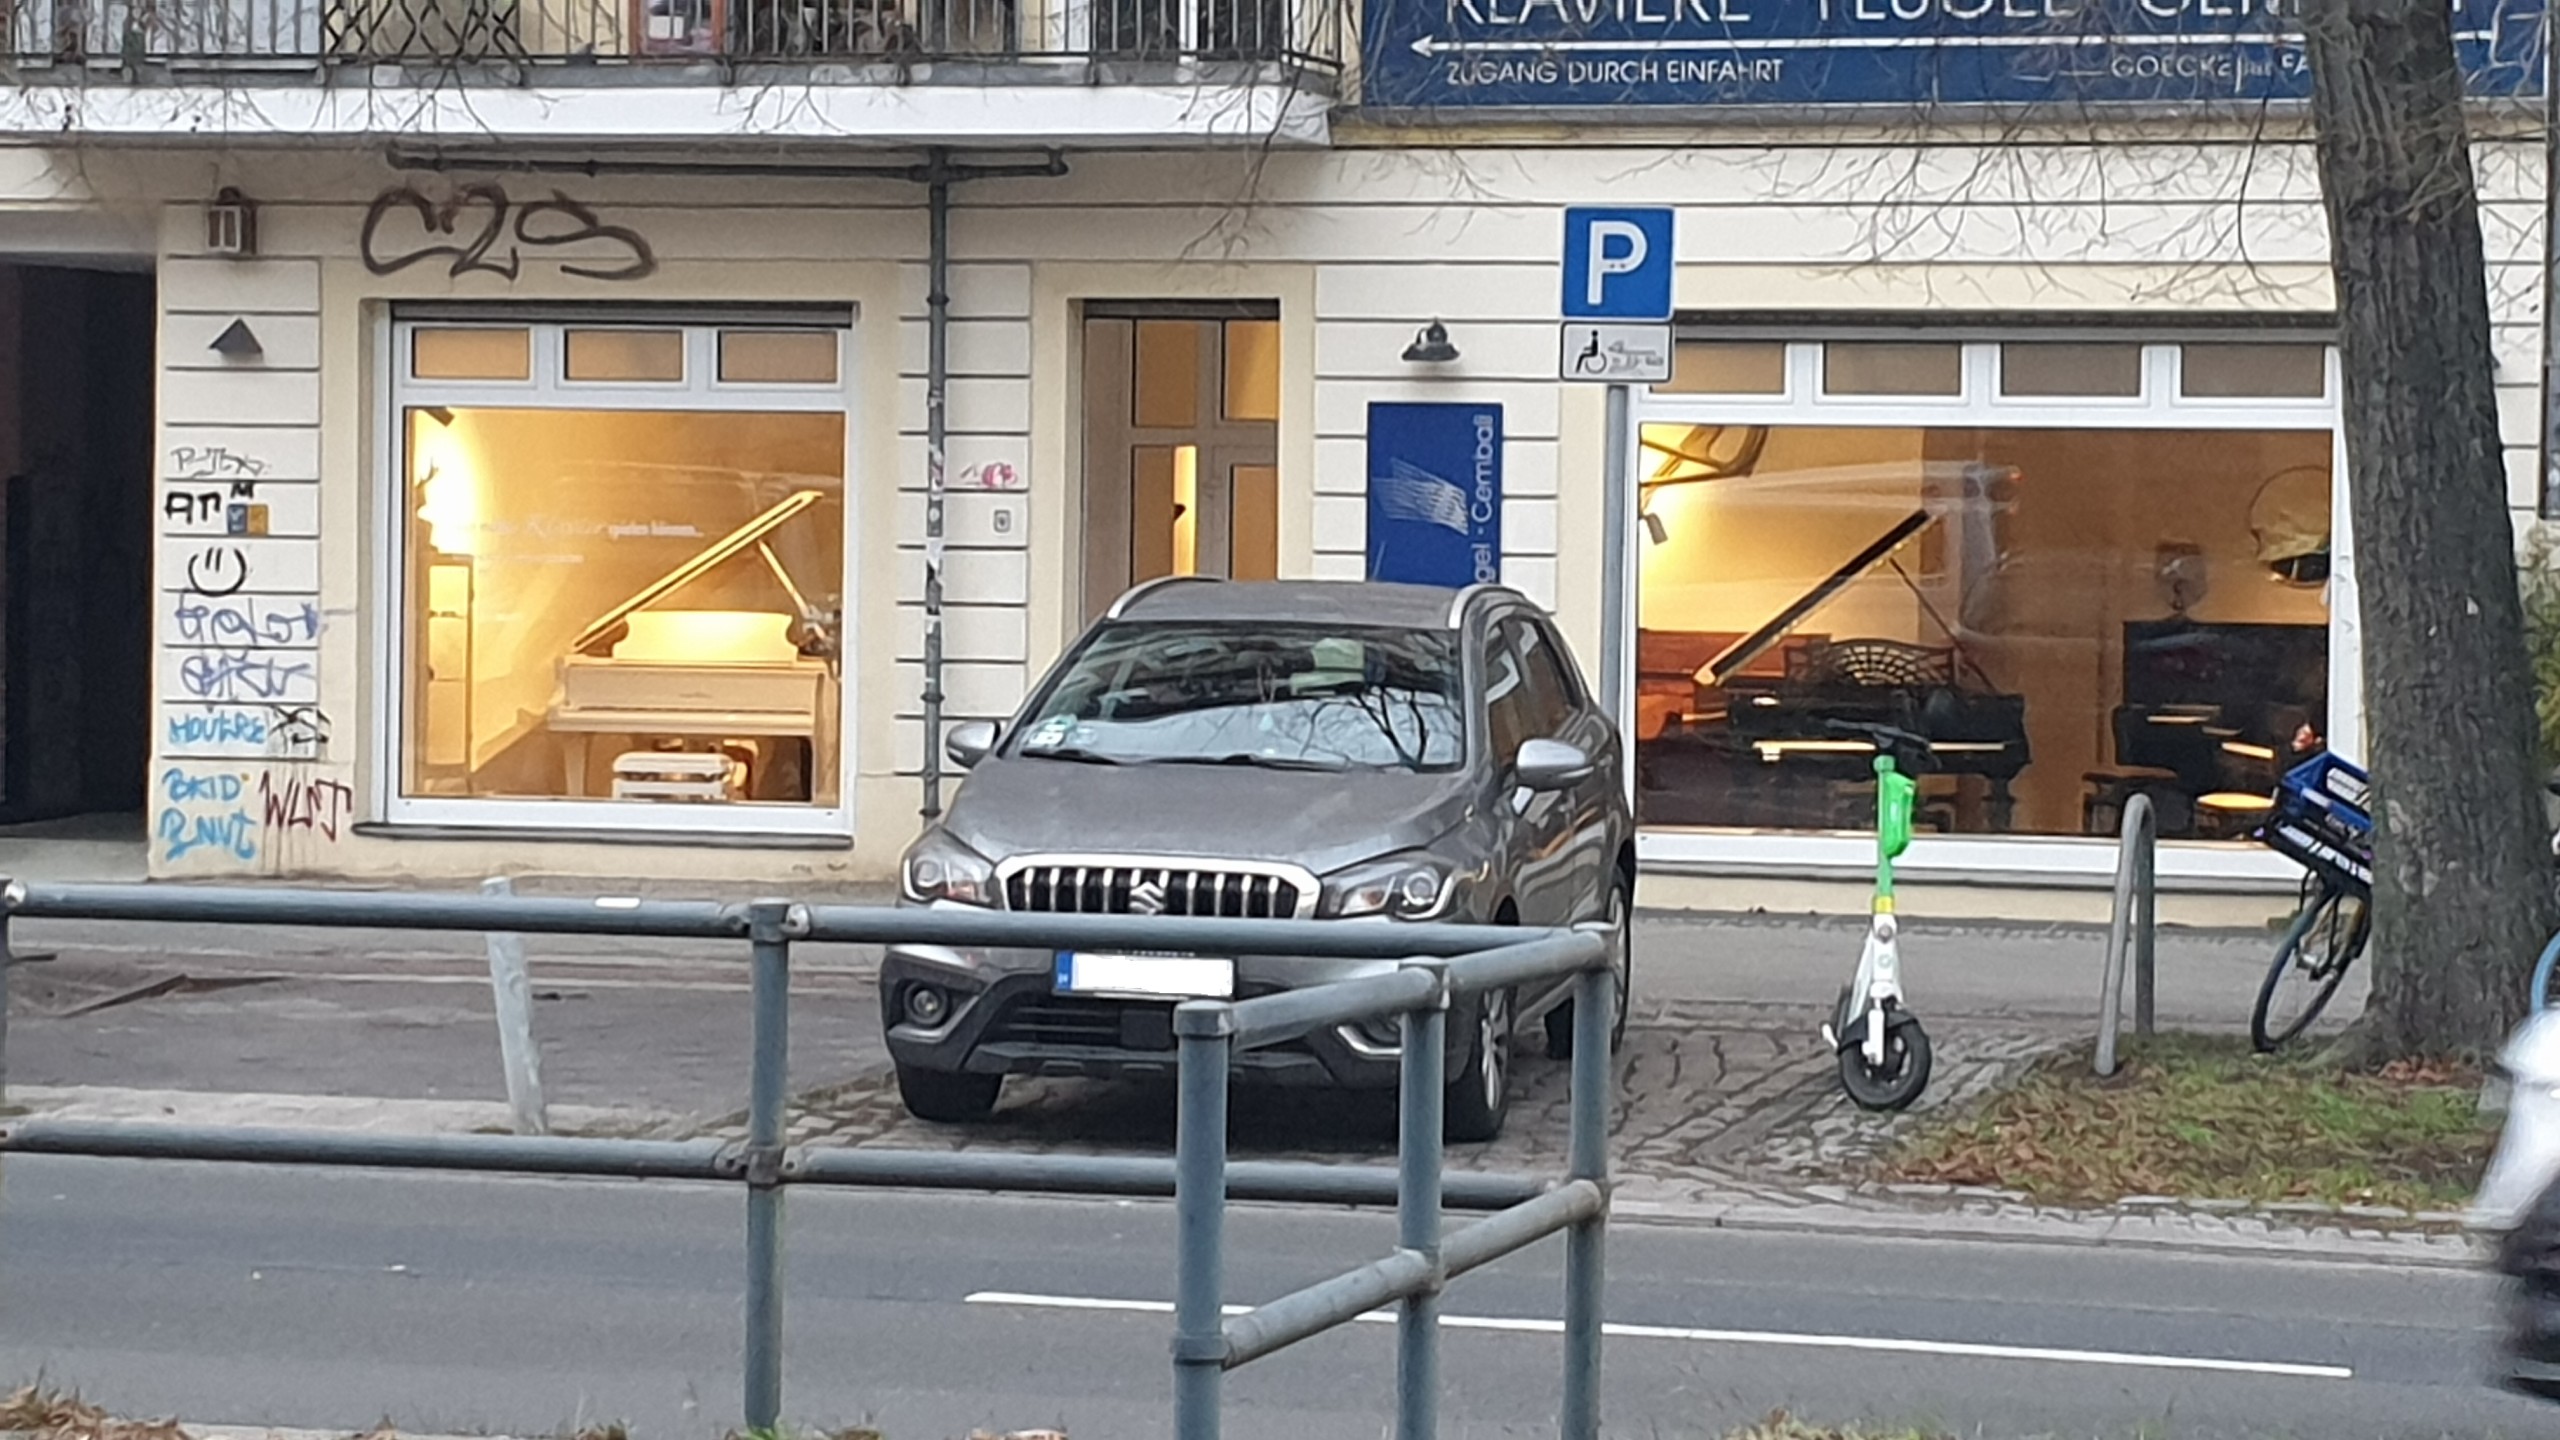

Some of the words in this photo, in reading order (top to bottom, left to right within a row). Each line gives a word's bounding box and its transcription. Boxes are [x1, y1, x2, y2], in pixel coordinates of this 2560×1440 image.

[1446, 60, 1558, 84] ZUGANG
[1568, 59, 1658, 83] DURCH
[1667, 58, 1784, 82] EINFAHRT
[1587, 220, 1648, 305] P
